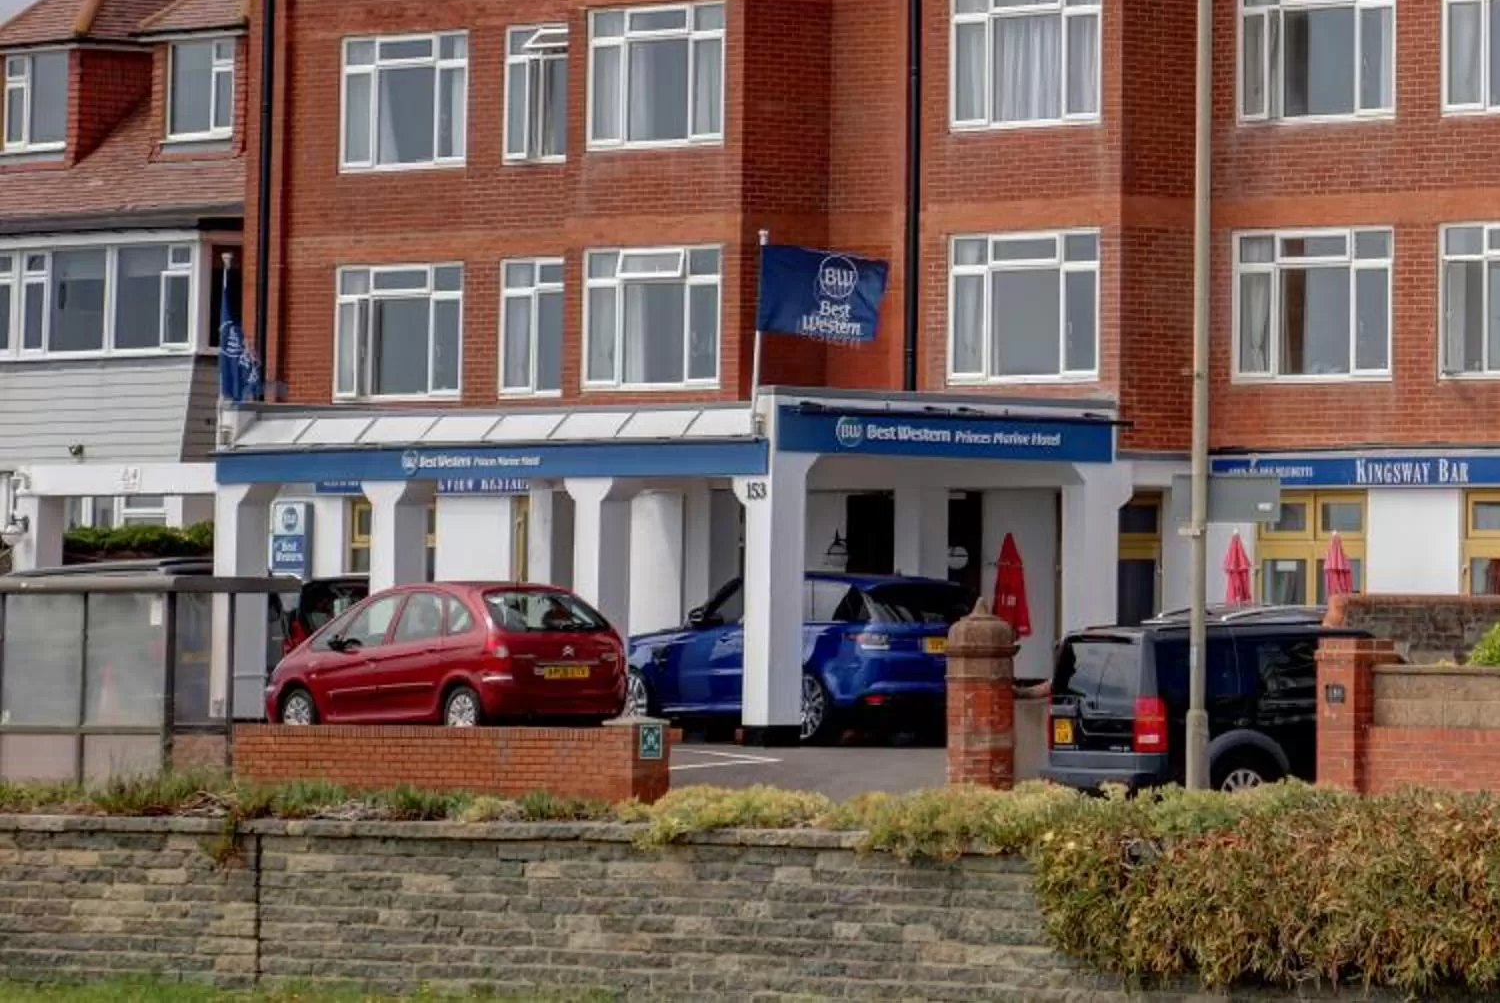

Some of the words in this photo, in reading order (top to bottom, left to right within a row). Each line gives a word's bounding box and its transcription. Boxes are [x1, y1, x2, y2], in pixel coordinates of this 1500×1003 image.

[824, 267, 854, 287] BW
[820, 299, 852, 318] Best
[801, 314, 861, 336] Western
[866, 423, 896, 441] Best
[897, 425, 950, 443] Western
[1355, 458, 1431, 484] KINGSWAY
[1438, 458, 1469, 483] BAR
[747, 481, 767, 500] 153
